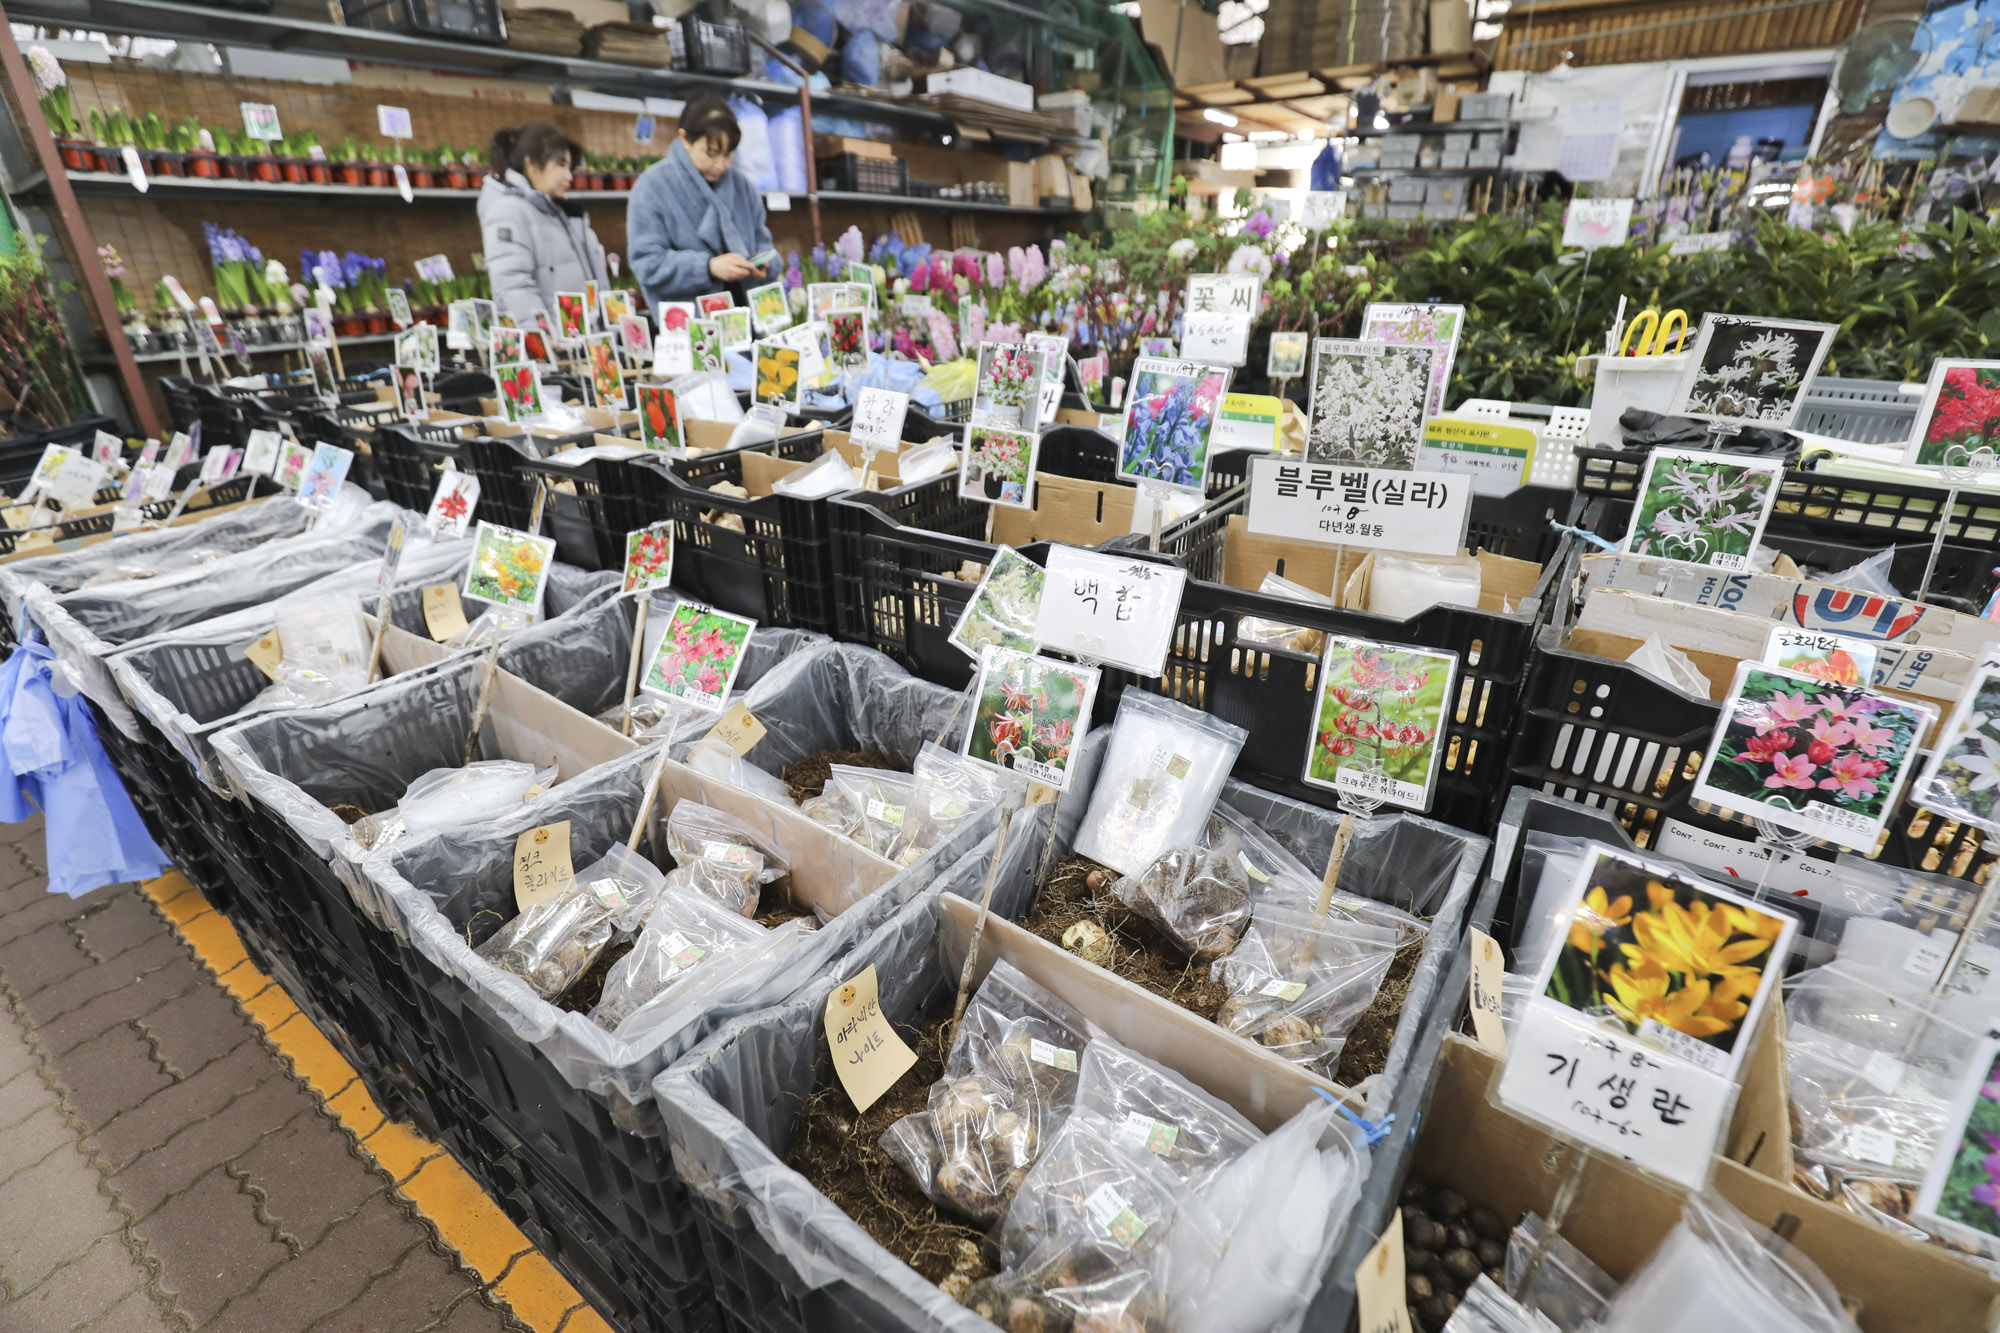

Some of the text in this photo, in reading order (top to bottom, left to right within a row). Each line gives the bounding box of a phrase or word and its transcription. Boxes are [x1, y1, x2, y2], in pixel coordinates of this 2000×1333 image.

[1274, 465, 1449, 509] 블루벨(실라)
[1671, 826, 1697, 843] CONT.
[1703, 838, 1731, 852] CONT.
[1736, 847, 1744, 855] 5
